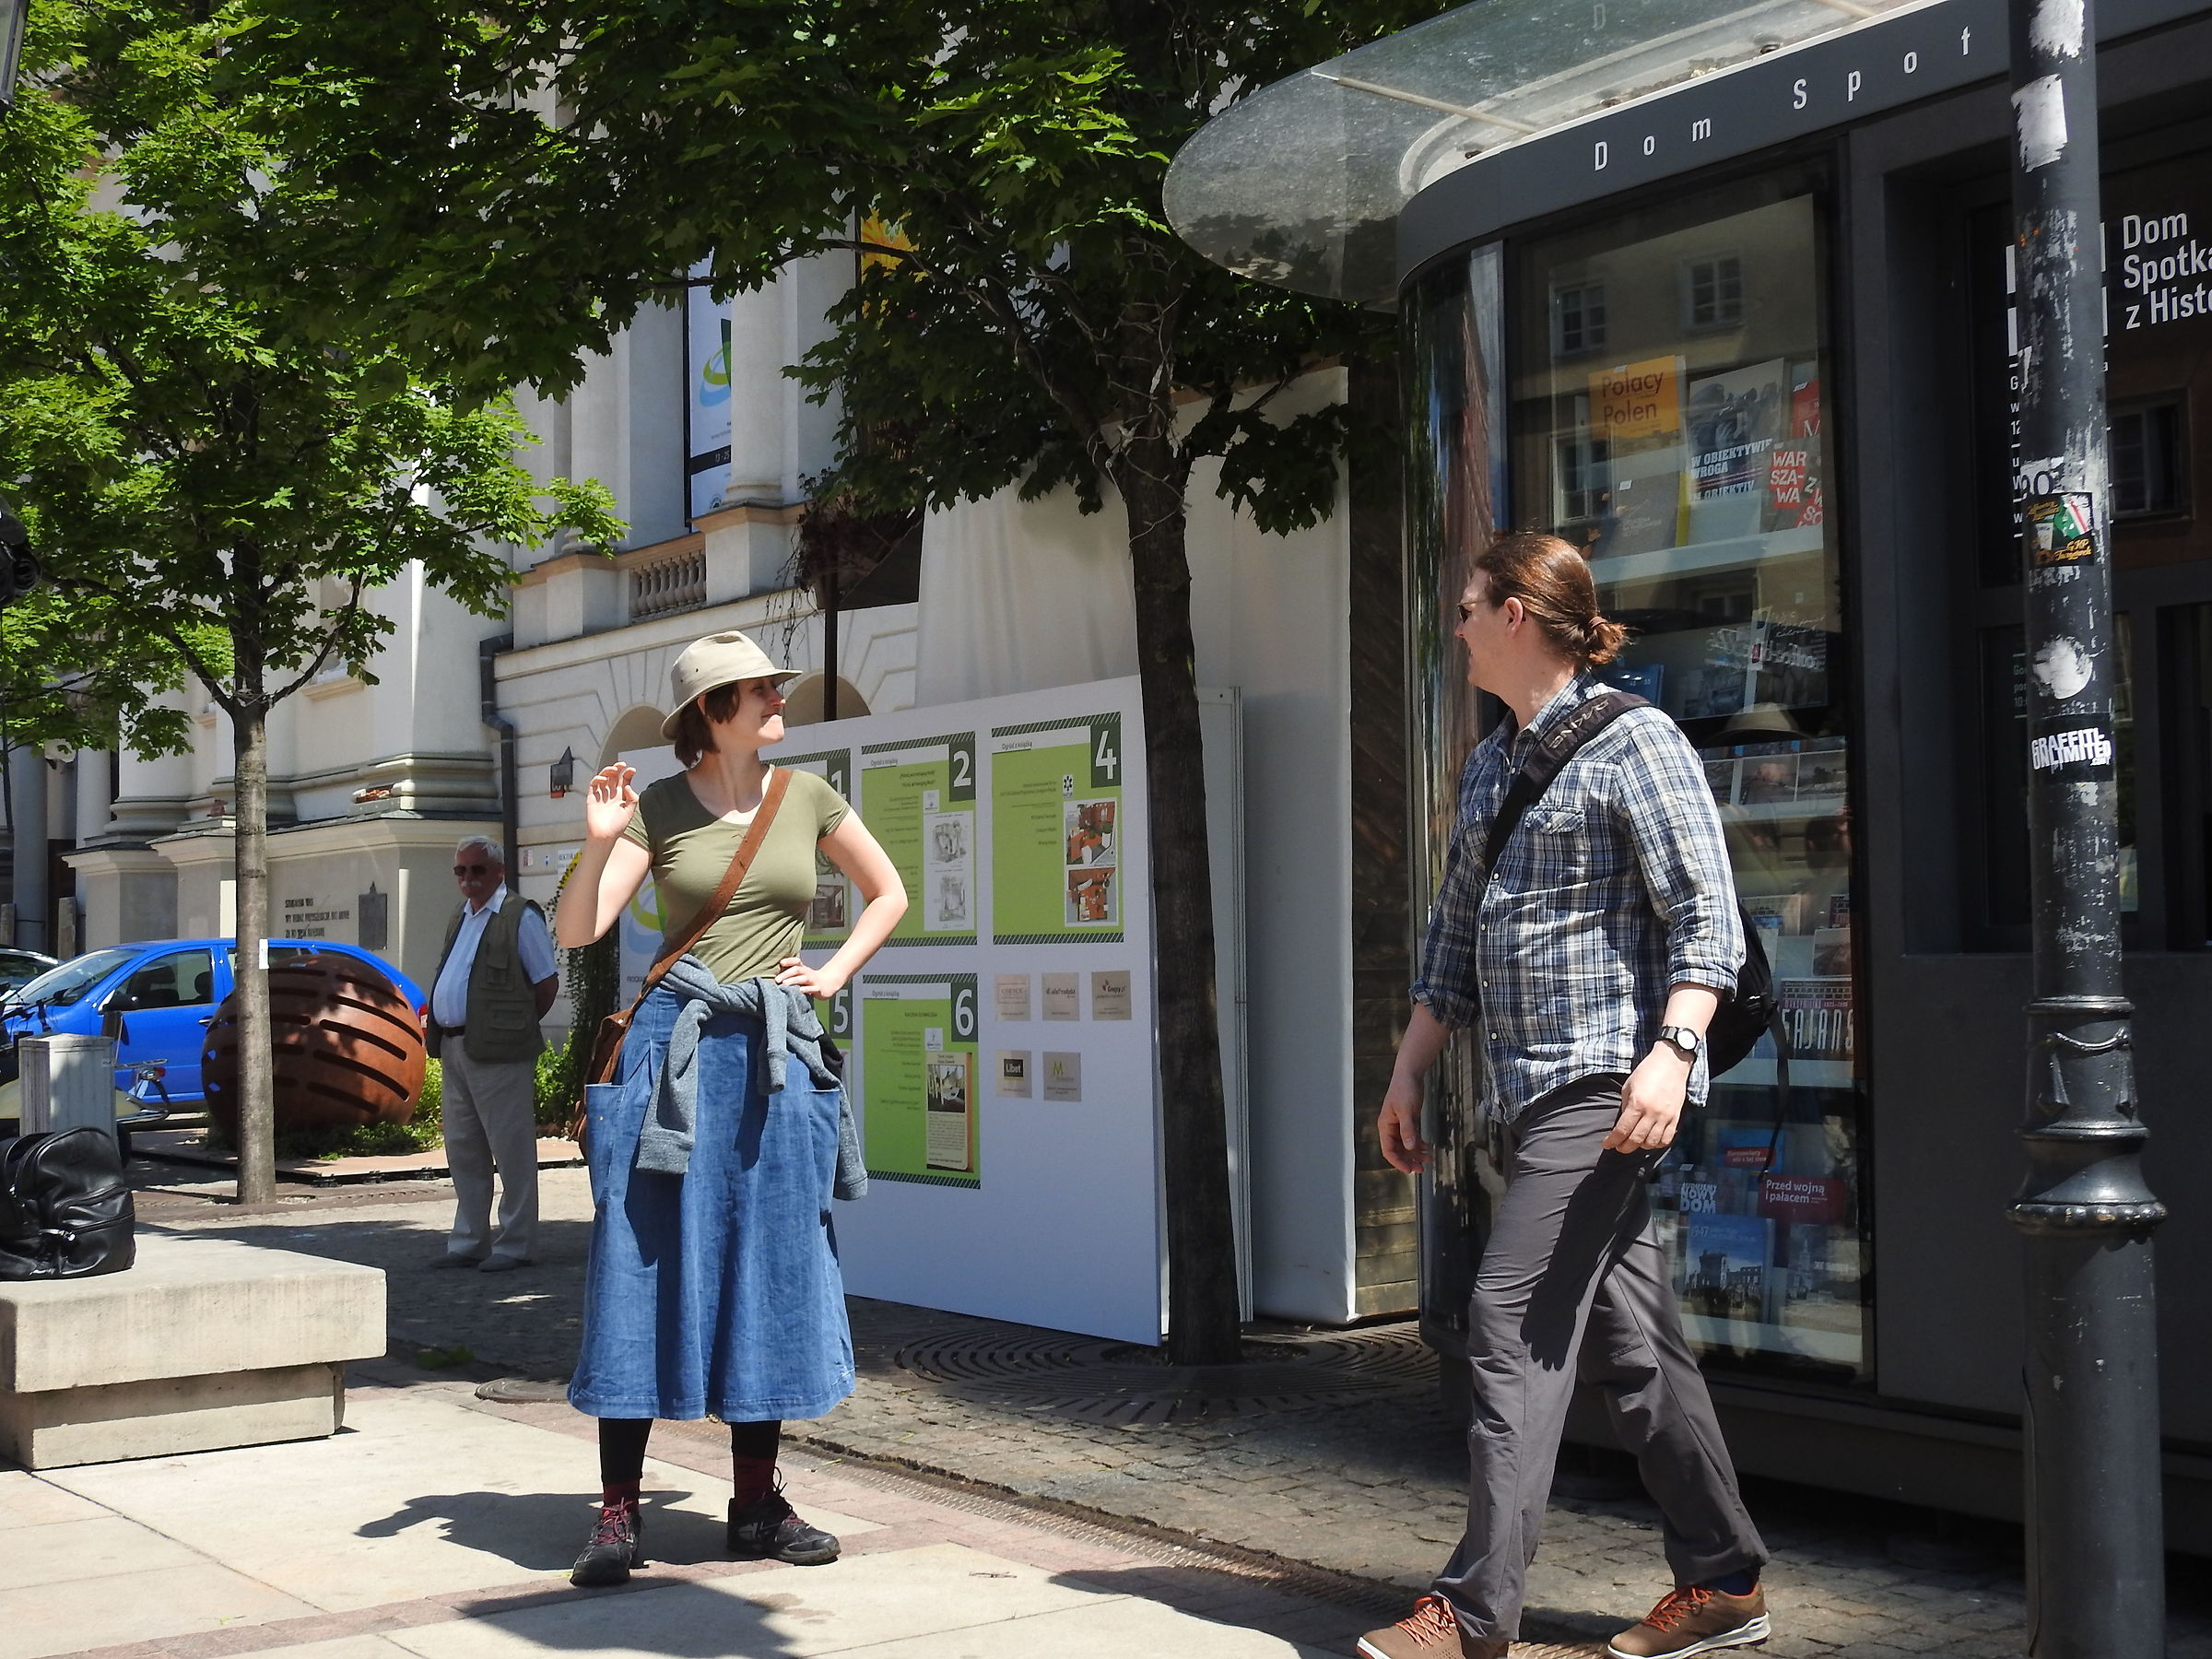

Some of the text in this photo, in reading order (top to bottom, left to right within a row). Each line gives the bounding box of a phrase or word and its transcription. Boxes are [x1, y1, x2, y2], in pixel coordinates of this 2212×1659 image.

[1594, 116, 1712, 171] Dom
[2123, 212, 2188, 250] Dom
[2126, 304, 2140, 329] z
[1602, 372, 1664, 398] Polacy
[1604, 400, 1657, 428] Polen
[1772, 451, 1807, 467] WAR
[1771, 469, 1806, 486] SZA-
[1776, 488, 1801, 504] WA
[953, 750, 971, 787] 2
[1096, 730, 1117, 780] 4
[831, 770, 847, 801] 1
[834, 989, 848, 1033] 5
[955, 989, 974, 1036] 6
[1767, 1180, 1825, 1195] Przed wojną
[1770, 1191, 1809, 1203] pałacem
[1680, 1199, 1716, 1213] DOM
